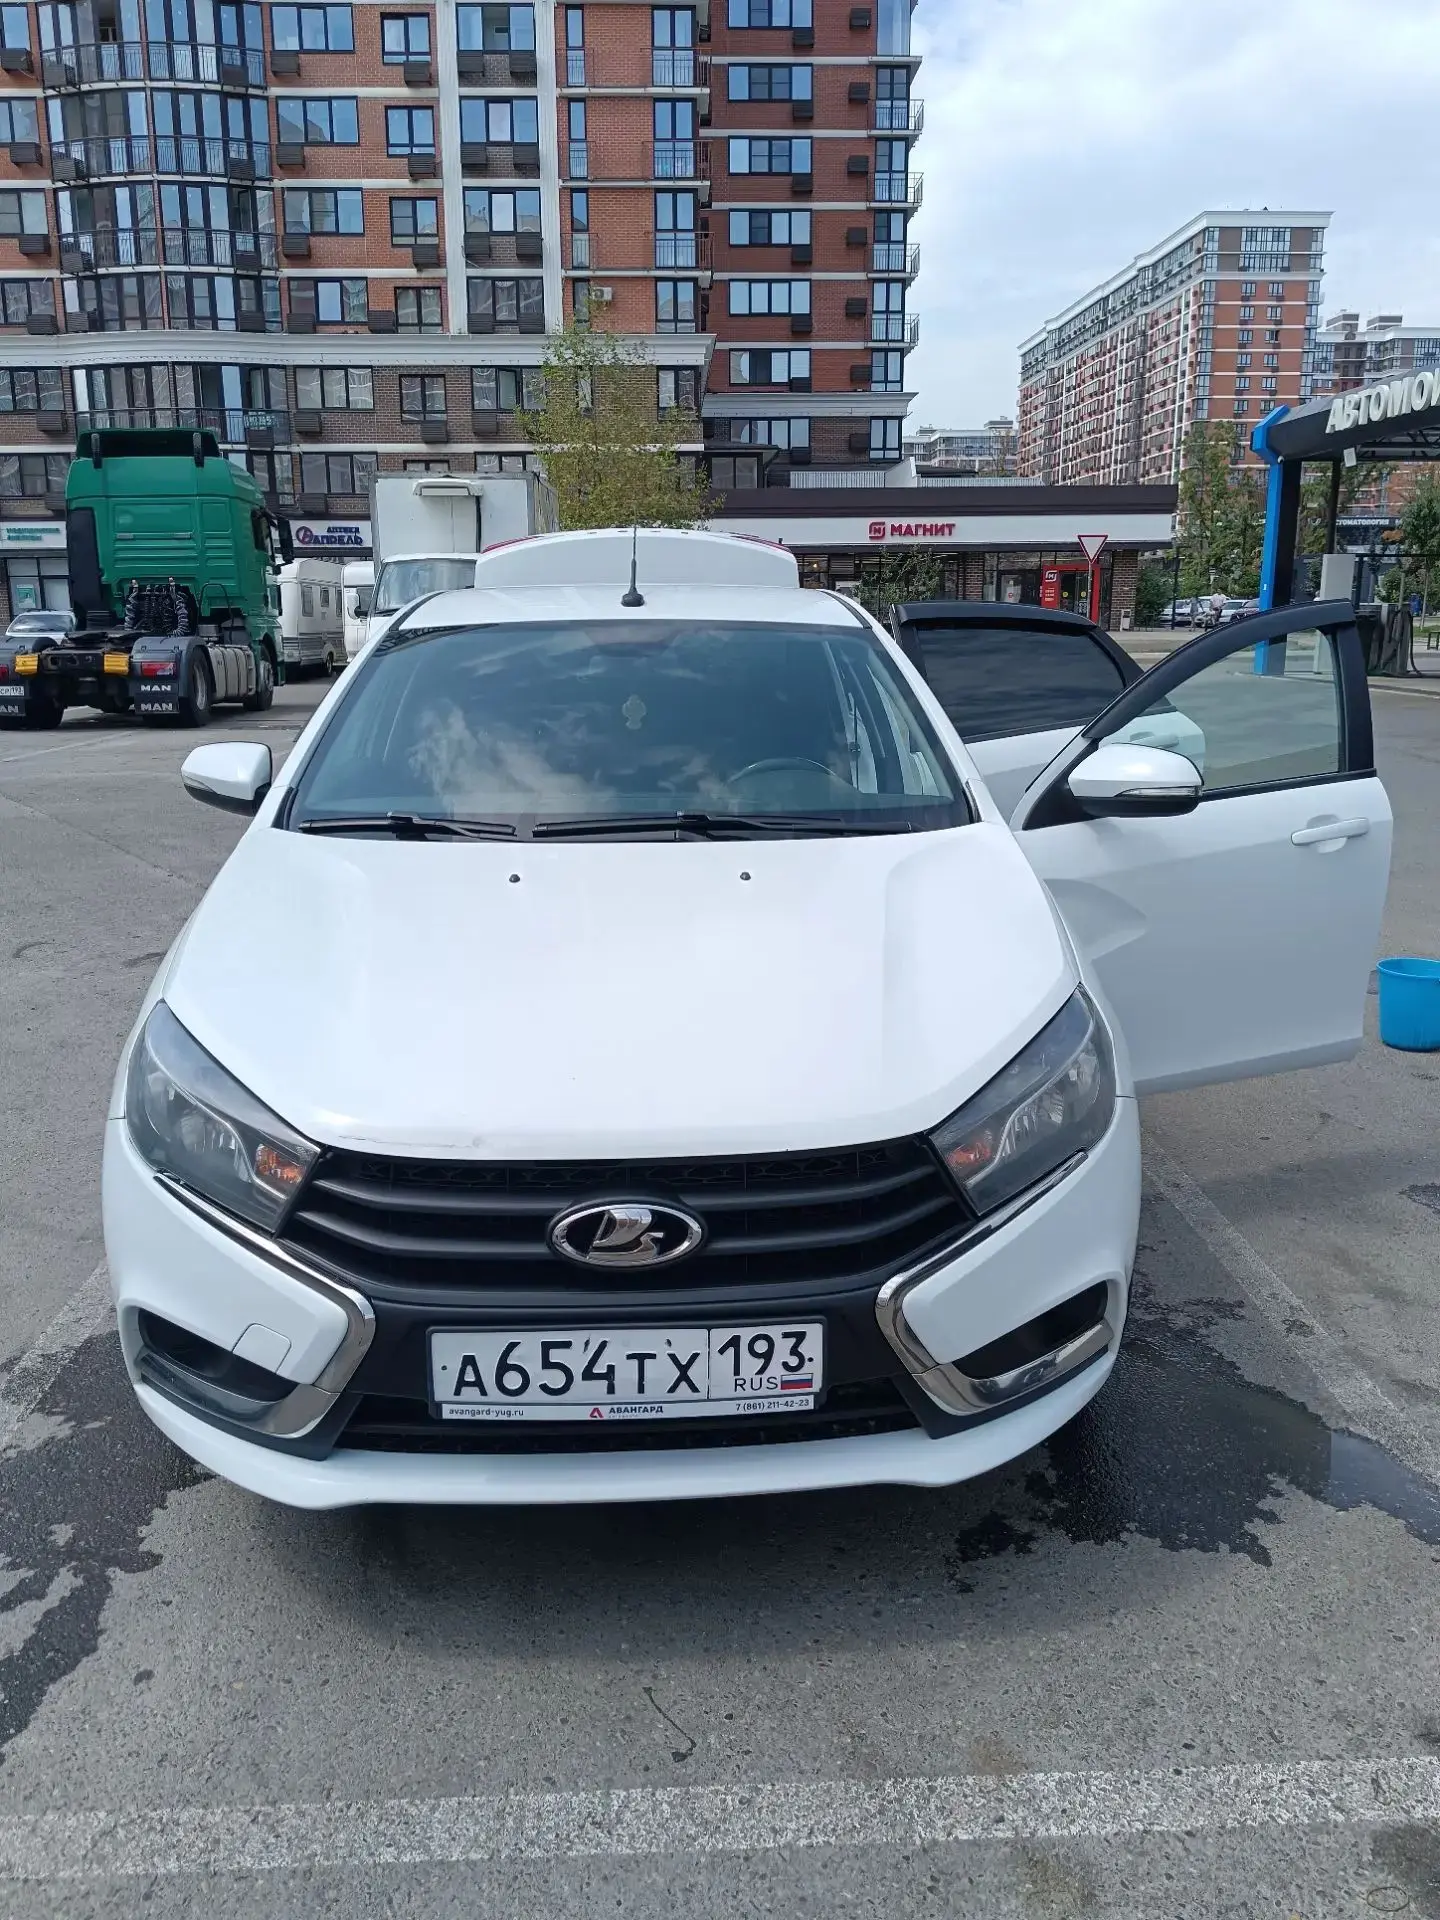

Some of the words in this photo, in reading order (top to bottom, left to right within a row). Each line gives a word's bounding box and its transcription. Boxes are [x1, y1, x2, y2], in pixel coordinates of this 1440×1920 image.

[890, 523, 956, 536] МАГНИТ
[140, 684, 172, 692] MAN
[0, 704, 19, 713] AN
[140, 702, 173, 712] MAN
[717, 1330, 808, 1377] 193
[734, 1375, 778, 1392] RUS
[609, 1405, 664, 1415] АВАНГАРД
[743, 1401, 765, 1412] (861)
[767, 1399, 810, 1409] 211-42-23
[449, 1407, 524, 1418] avangard-yug.ru
